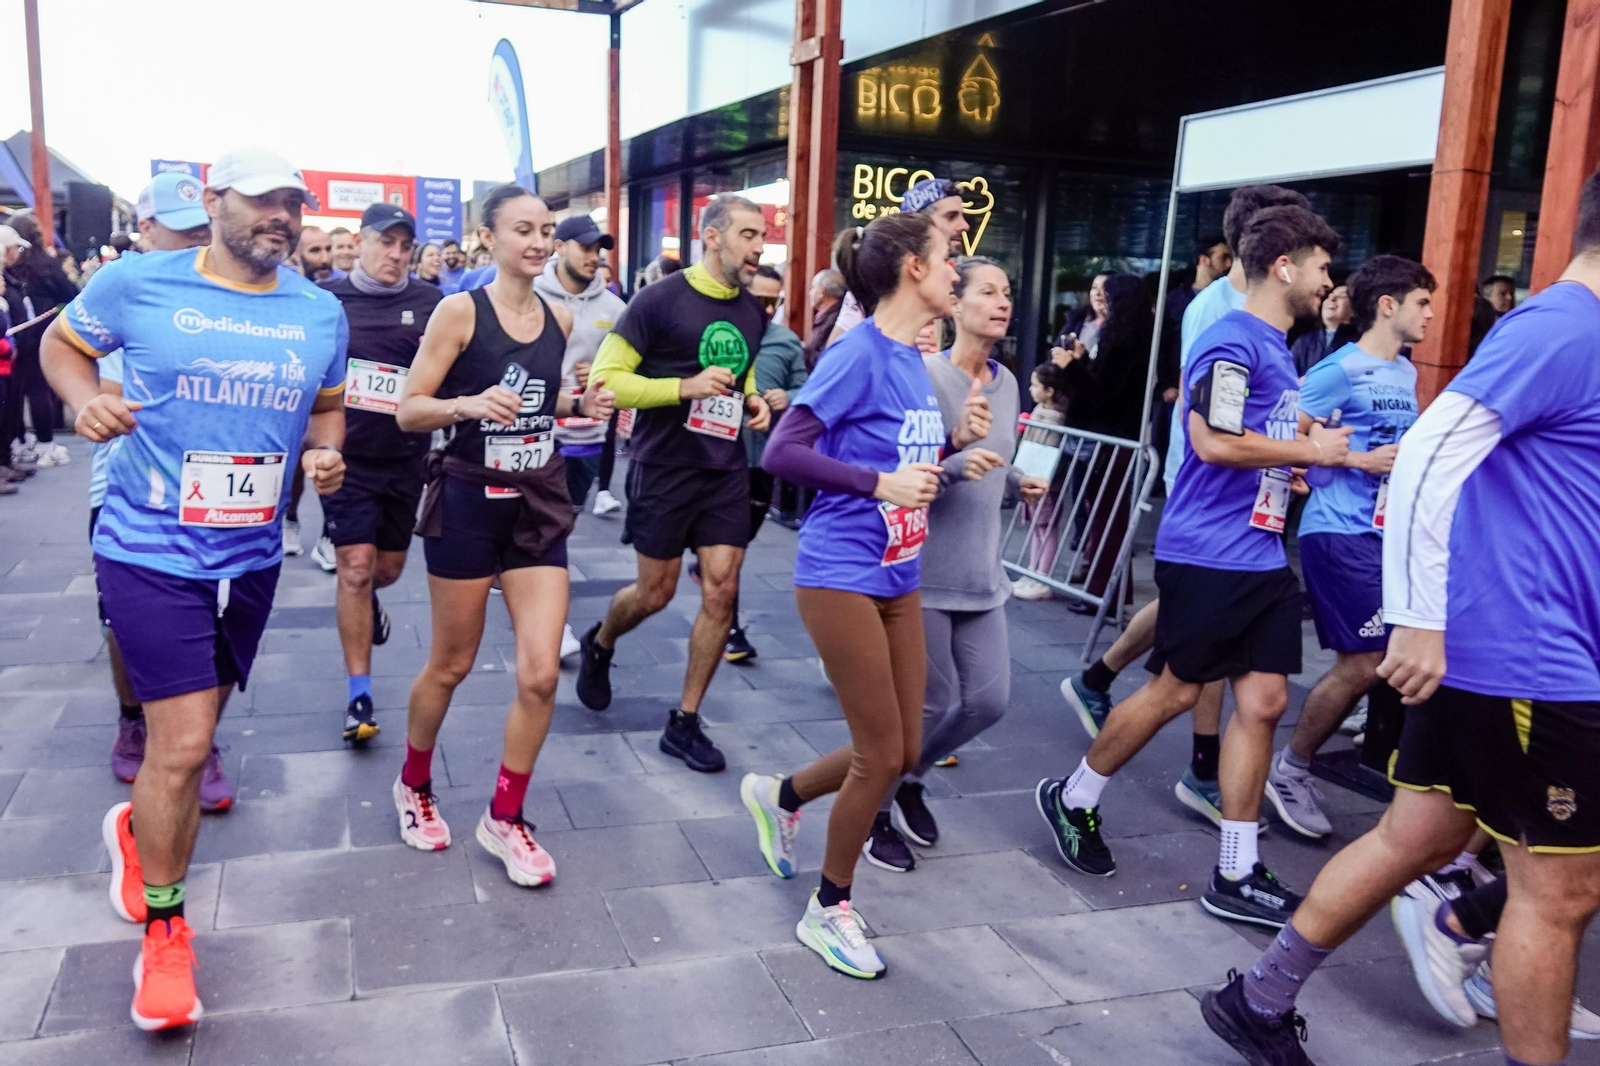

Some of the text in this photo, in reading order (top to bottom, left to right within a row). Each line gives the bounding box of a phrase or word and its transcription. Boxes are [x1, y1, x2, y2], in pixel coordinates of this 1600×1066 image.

[852, 200, 876, 220] de
[173, 308, 306, 341] mediolanum
[281, 363, 306, 382] 15K
[368, 375, 396, 394] 120
[708, 398, 734, 418] 253
[511, 449, 543, 471] 327
[226, 473, 254, 497] 14
[203, 508, 265, 524] Alcampo
